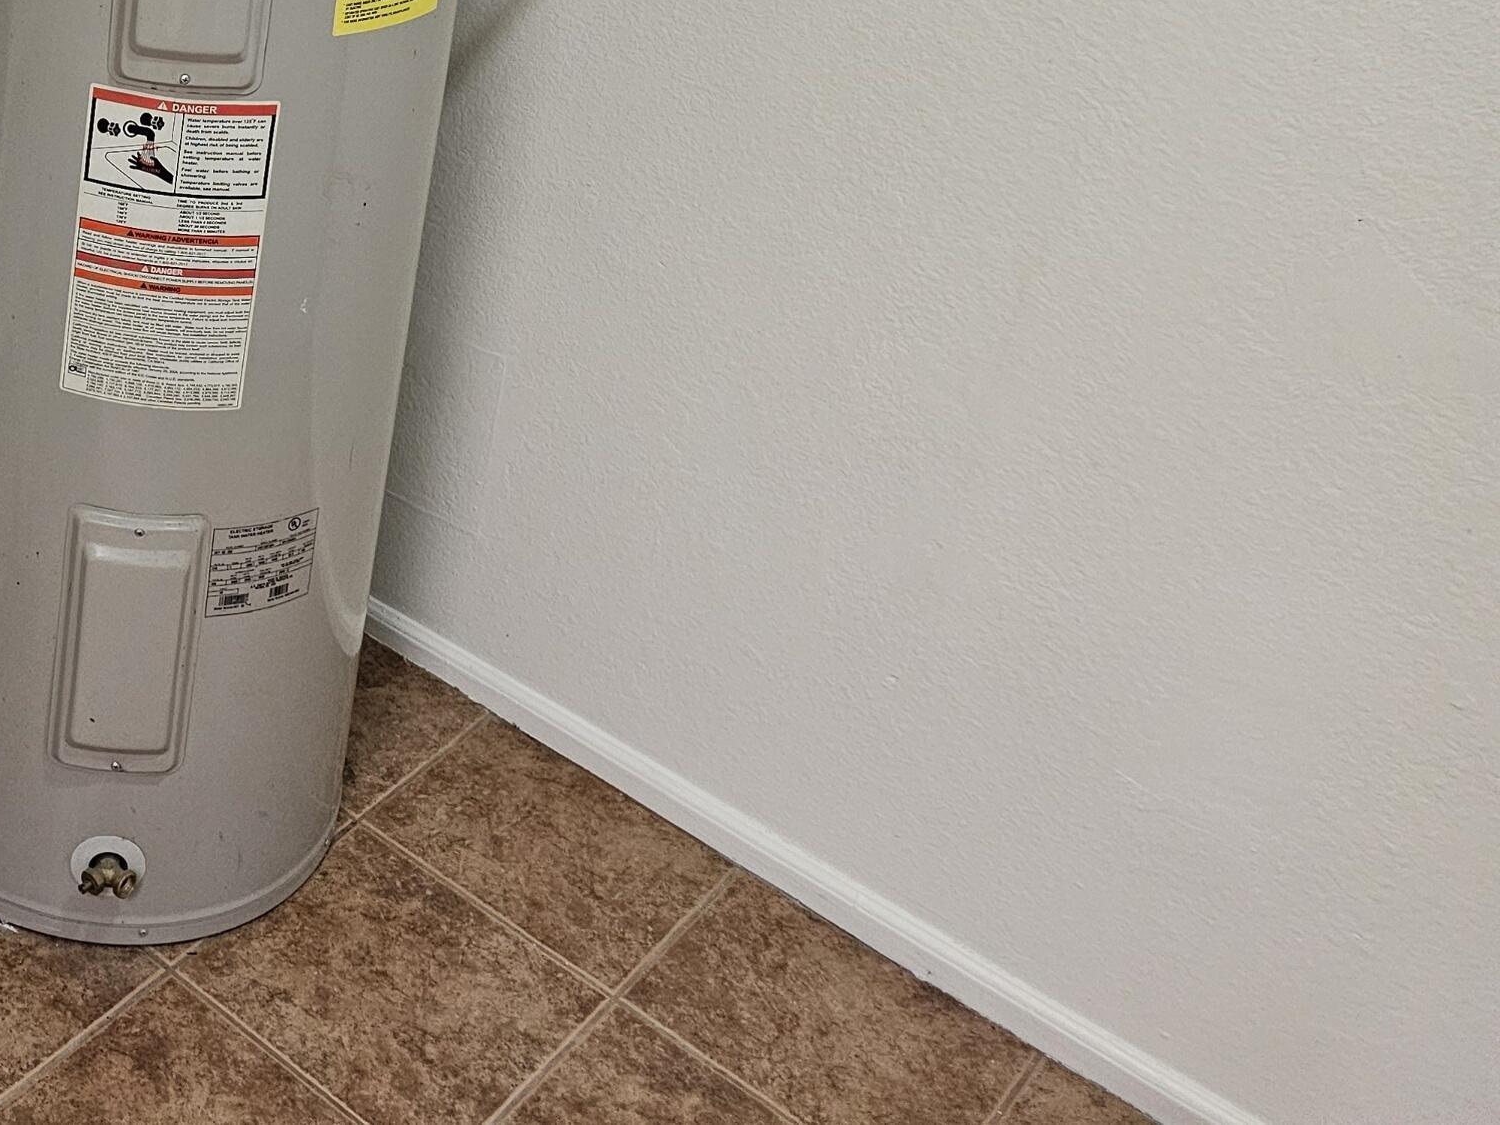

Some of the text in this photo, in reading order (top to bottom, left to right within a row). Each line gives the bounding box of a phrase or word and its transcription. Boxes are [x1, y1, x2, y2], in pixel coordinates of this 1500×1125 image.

[172, 103, 217, 114] DANGER
[134, 232, 167, 241] WARNING
[172, 236, 219, 244] ADVERTENCIA
[151, 268, 183, 276] DANGER
[149, 284, 181, 293] WARNING
